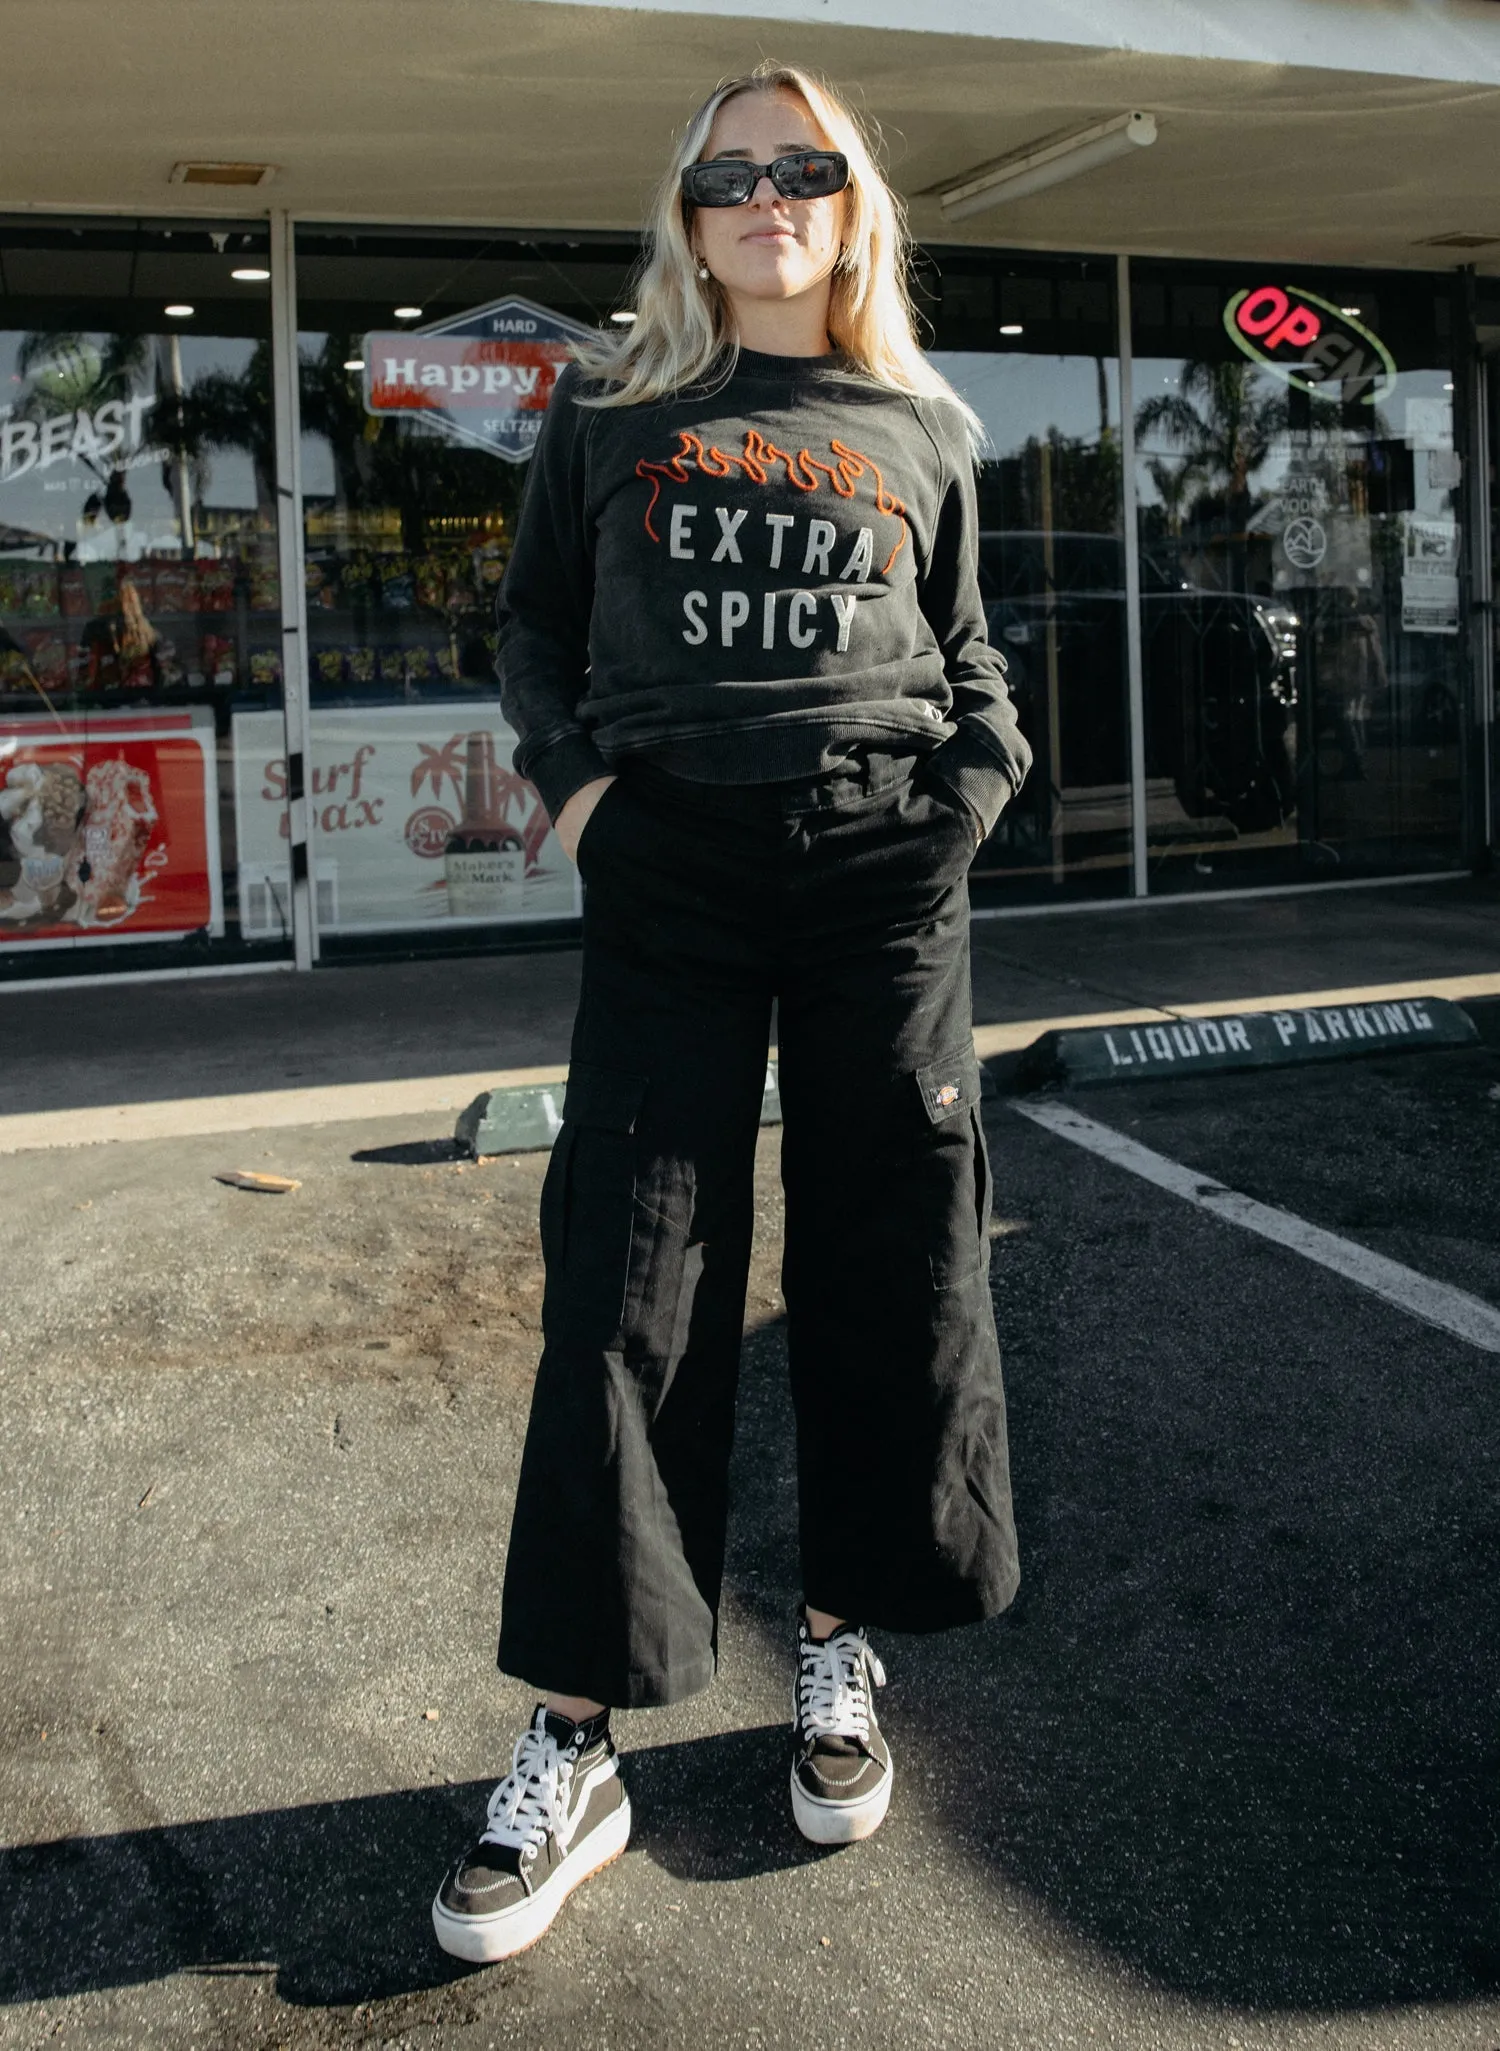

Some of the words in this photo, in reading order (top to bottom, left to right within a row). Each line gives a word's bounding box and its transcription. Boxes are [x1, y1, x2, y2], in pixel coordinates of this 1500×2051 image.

[493, 319, 537, 333] HARD
[1237, 286, 1384, 402] OPEN
[383, 358, 542, 395] Happy
[0, 392, 156, 482] BEAST
[669, 504, 874, 583] EXTRA
[682, 590, 857, 652] SPICY
[262, 745, 376, 801] Surf
[1104, 1019, 1252, 1066] LIQUOR
[1272, 1001, 1434, 1046] PARKING
